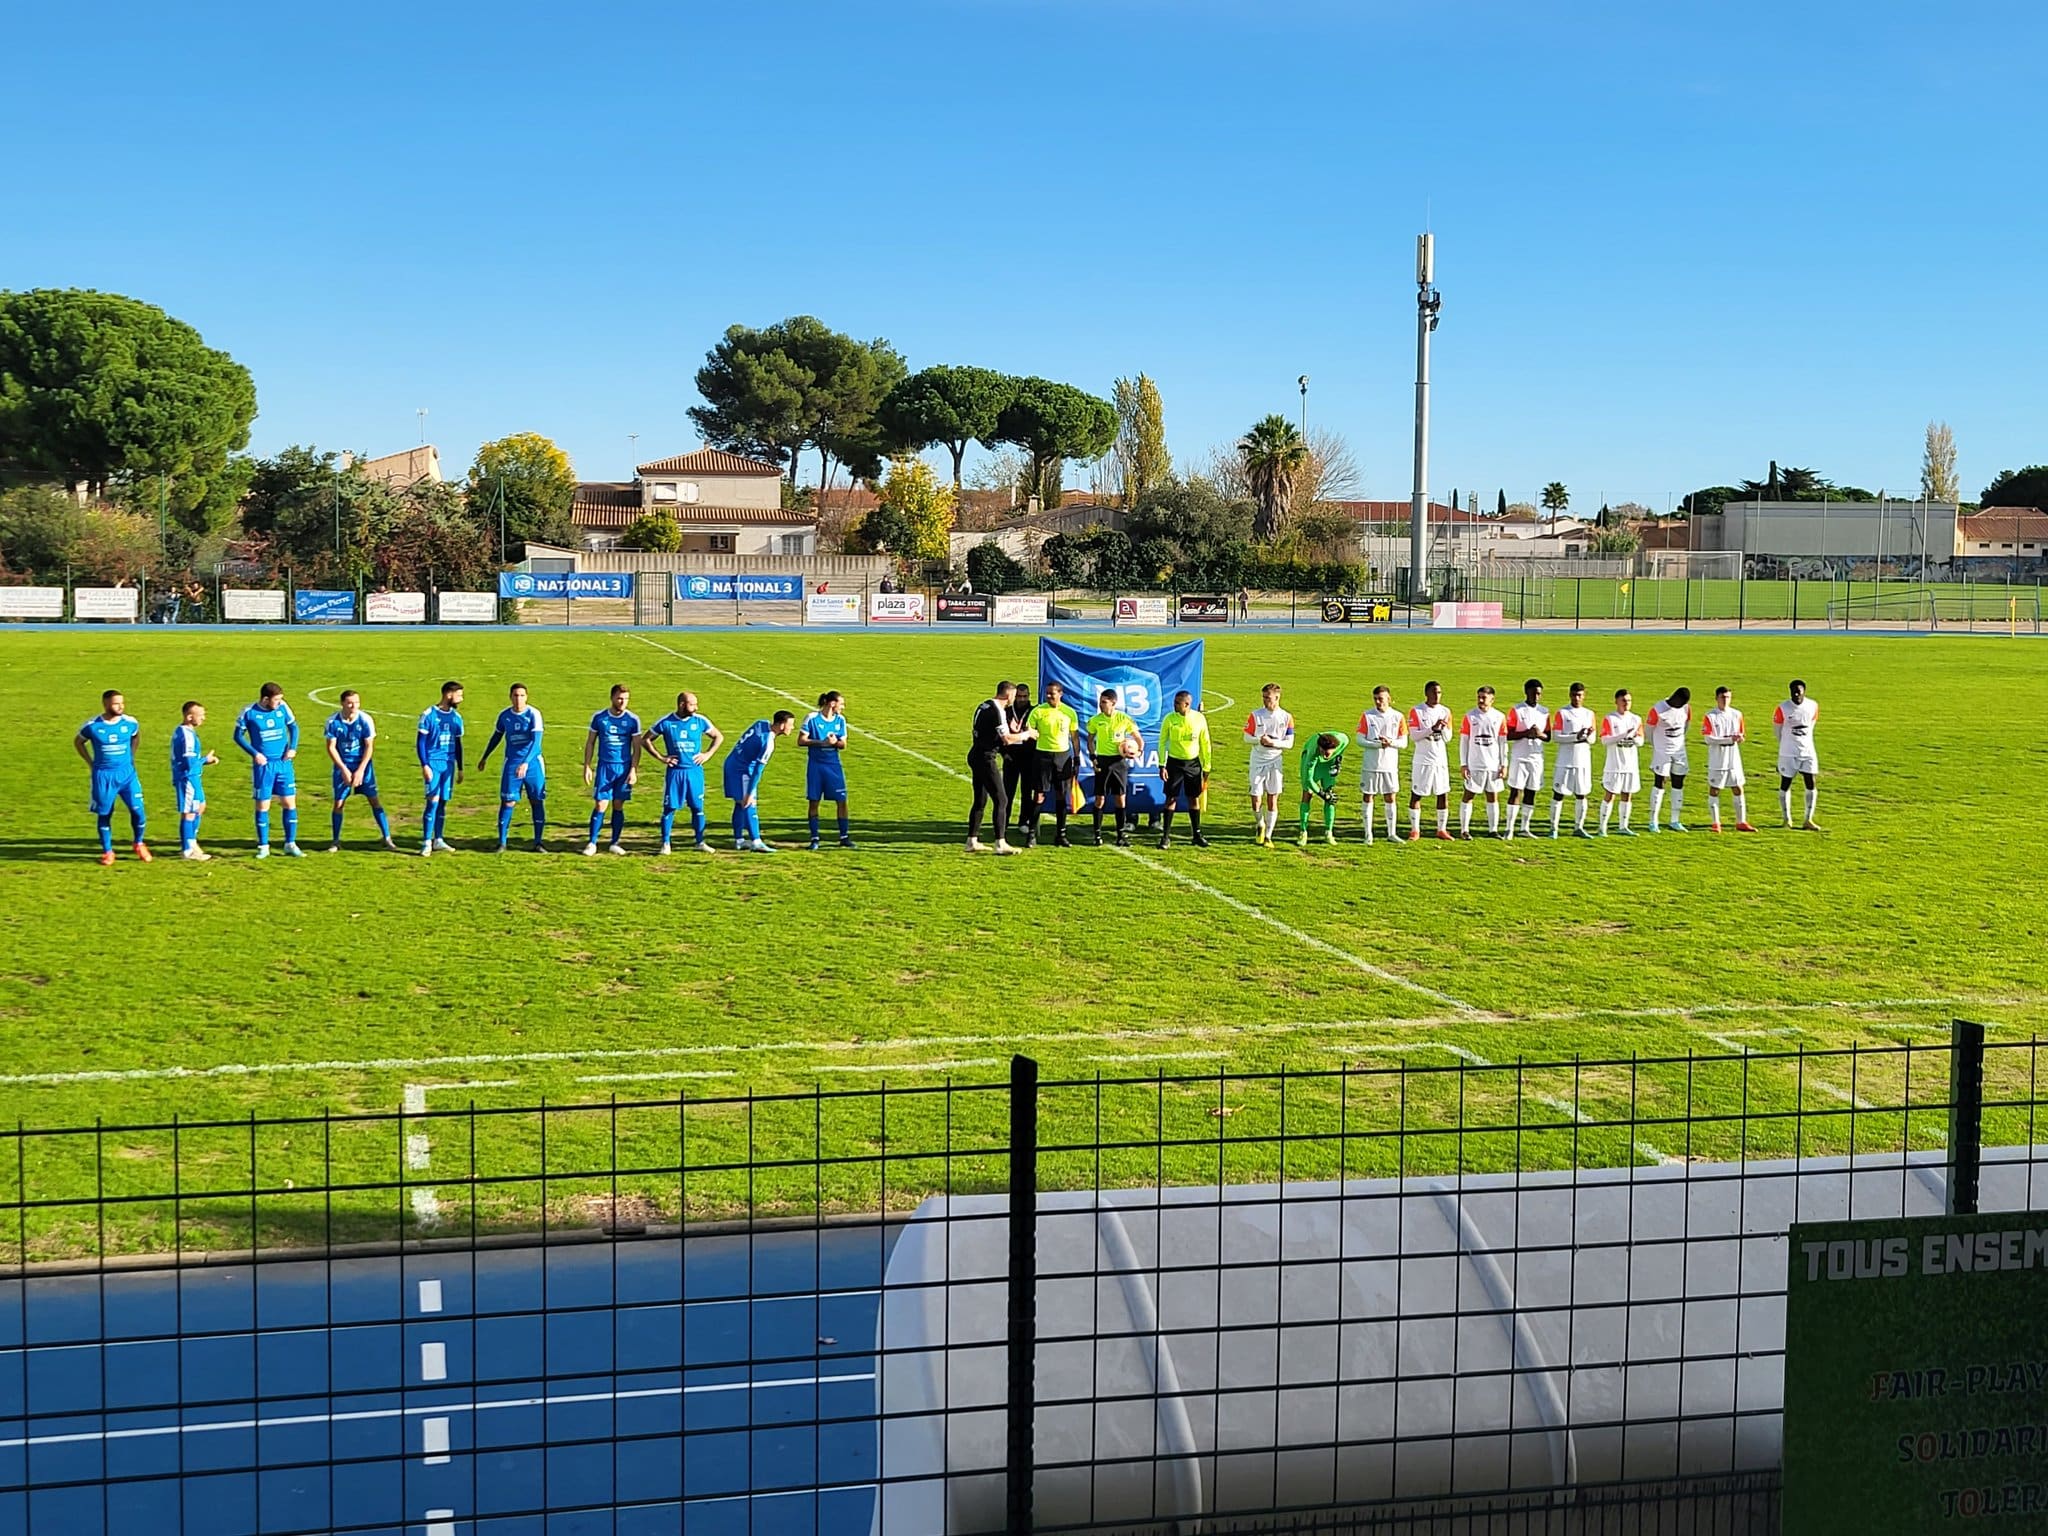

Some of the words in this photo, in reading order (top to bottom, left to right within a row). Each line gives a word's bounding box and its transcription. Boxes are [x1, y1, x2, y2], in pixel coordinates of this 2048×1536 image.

[537, 579, 610, 591] NATIONAL
[611, 579, 622, 591] 3
[713, 582, 783, 593] NATIONAL
[783, 582, 793, 593] 3
[297, 607, 307, 617] Le
[307, 602, 329, 614] Saint
[328, 595, 350, 607] Pierre
[877, 597, 906, 610] plaza
[1801, 1237, 1909, 1281] TOUS
[1922, 1230, 2048, 1276] ENSEM
[1870, 1362, 2048, 1400] FAIR-PLAY
[1939, 1476, 2048, 1518] TOLÉR
